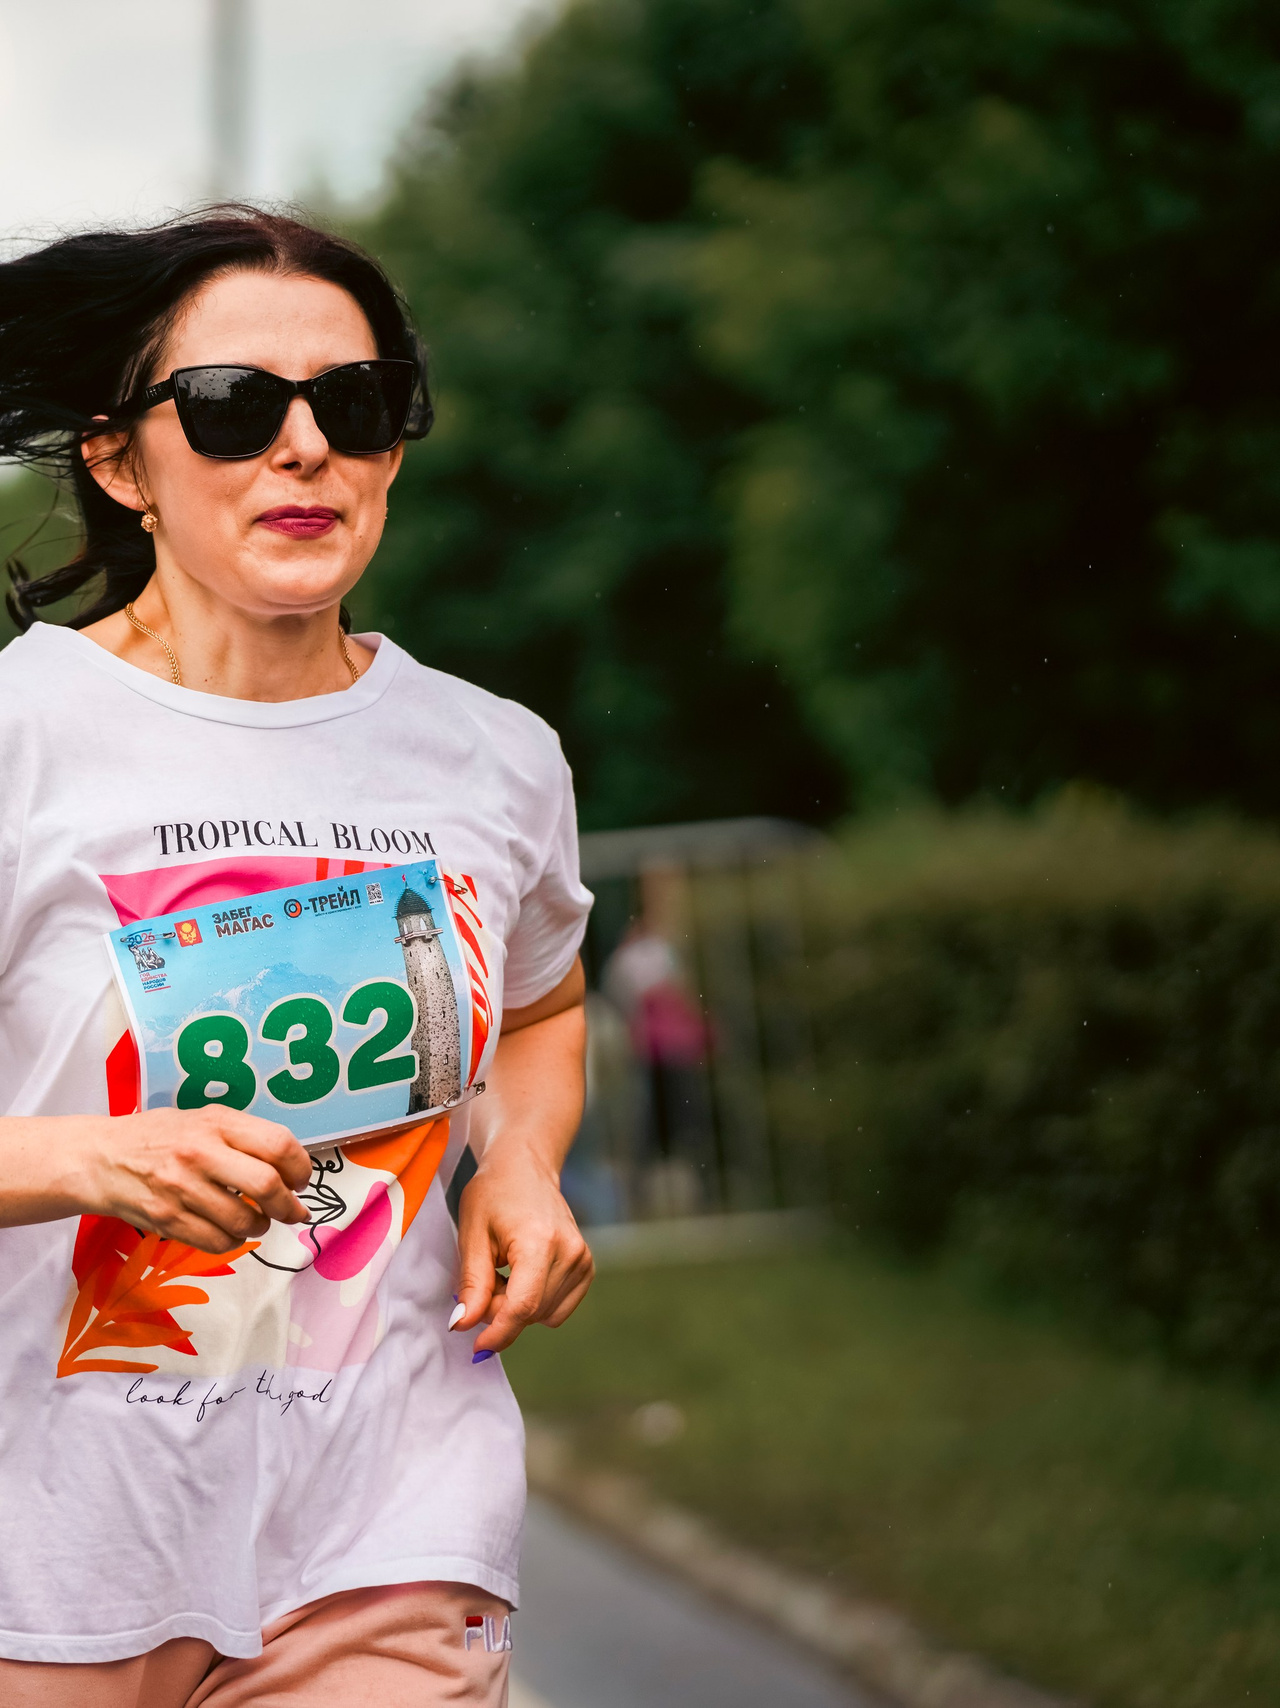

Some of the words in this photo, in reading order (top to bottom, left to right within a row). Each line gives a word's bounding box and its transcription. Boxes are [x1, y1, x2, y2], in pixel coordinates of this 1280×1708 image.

[153, 820, 318, 855] TROPICAL
[330, 822, 437, 855] BLOOM
[212, 906, 252, 924] ЗАБЕГ
[215, 914, 274, 938] МАГАС
[128, 932, 156, 947] 2026
[176, 979, 418, 1112] 832
[126, 1378, 194, 1405] look
[197, 1383, 246, 1422] for
